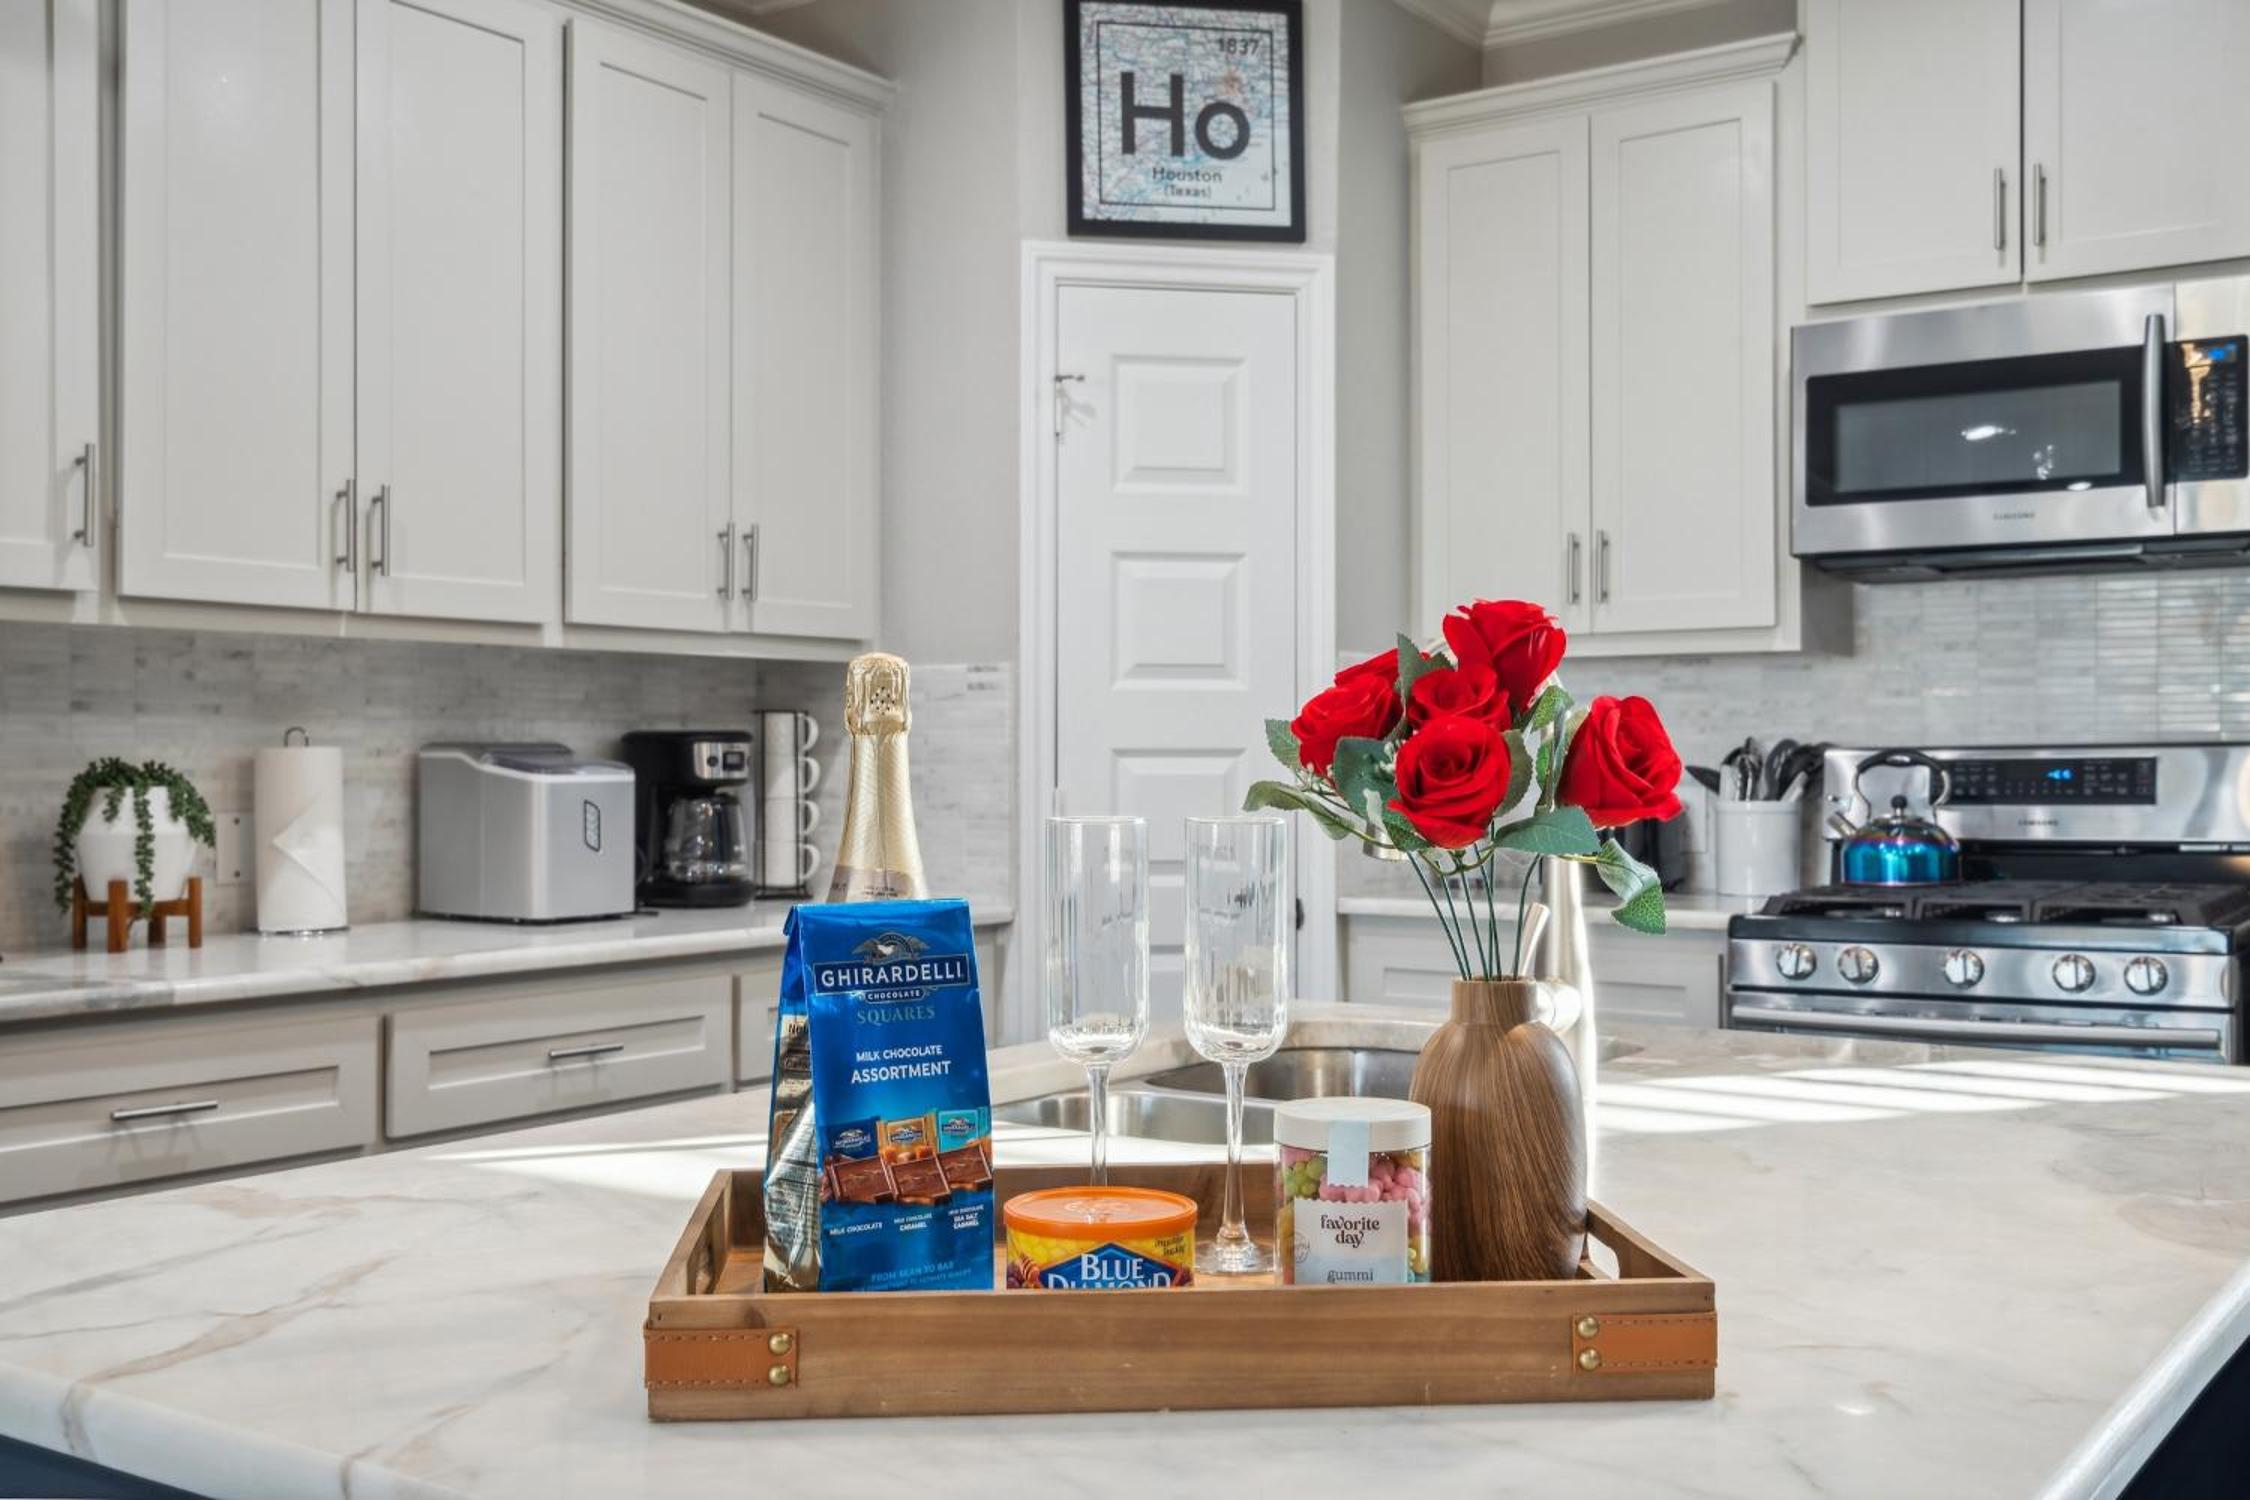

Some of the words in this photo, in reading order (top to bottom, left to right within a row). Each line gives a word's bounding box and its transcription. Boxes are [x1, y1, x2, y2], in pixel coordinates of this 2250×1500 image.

[1218, 37, 1260, 54] 1837
[1120, 71, 1250, 160] Ho
[1152, 167, 1222, 182] Houston
[1164, 184, 1212, 199] (Texas)
[821, 961, 962, 987] GHIRARDELLI
[867, 989, 921, 1000] CHOCOLATE
[857, 1004, 936, 1026] SQUARES
[856, 1050, 880, 1062] MILK
[883, 1044, 943, 1060] CHOCOLATE
[851, 1060, 952, 1084] ASSORTMENT
[1320, 1214, 1381, 1231] favorite
[1335, 1230, 1365, 1249] day
[1081, 1252, 1145, 1281] BLUE
[1327, 1267, 1374, 1284] gummi
